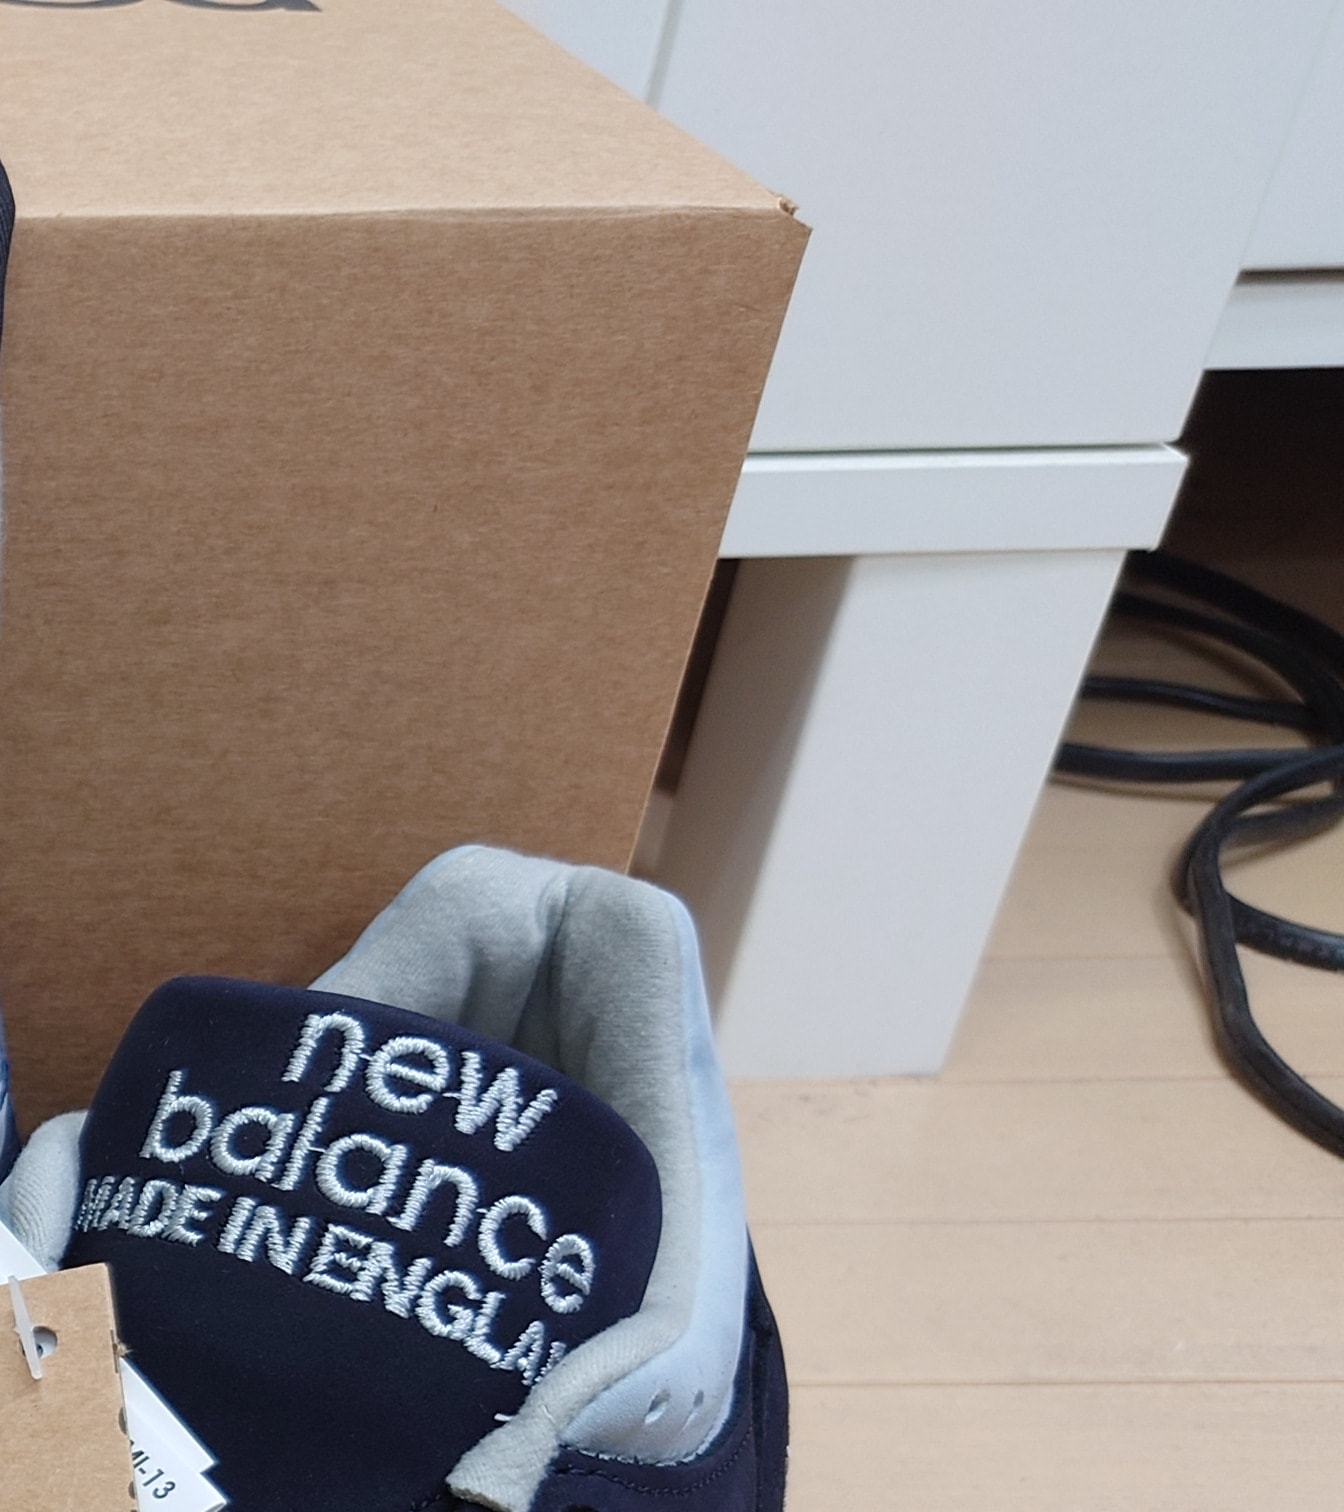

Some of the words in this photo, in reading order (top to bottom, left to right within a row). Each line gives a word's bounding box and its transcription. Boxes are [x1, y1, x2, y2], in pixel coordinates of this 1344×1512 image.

[282, 1011, 559, 1152] new
[75, 1175, 224, 1247] MADE
[217, 1197, 313, 1275] IN
[139, 1069, 597, 1314] balance
